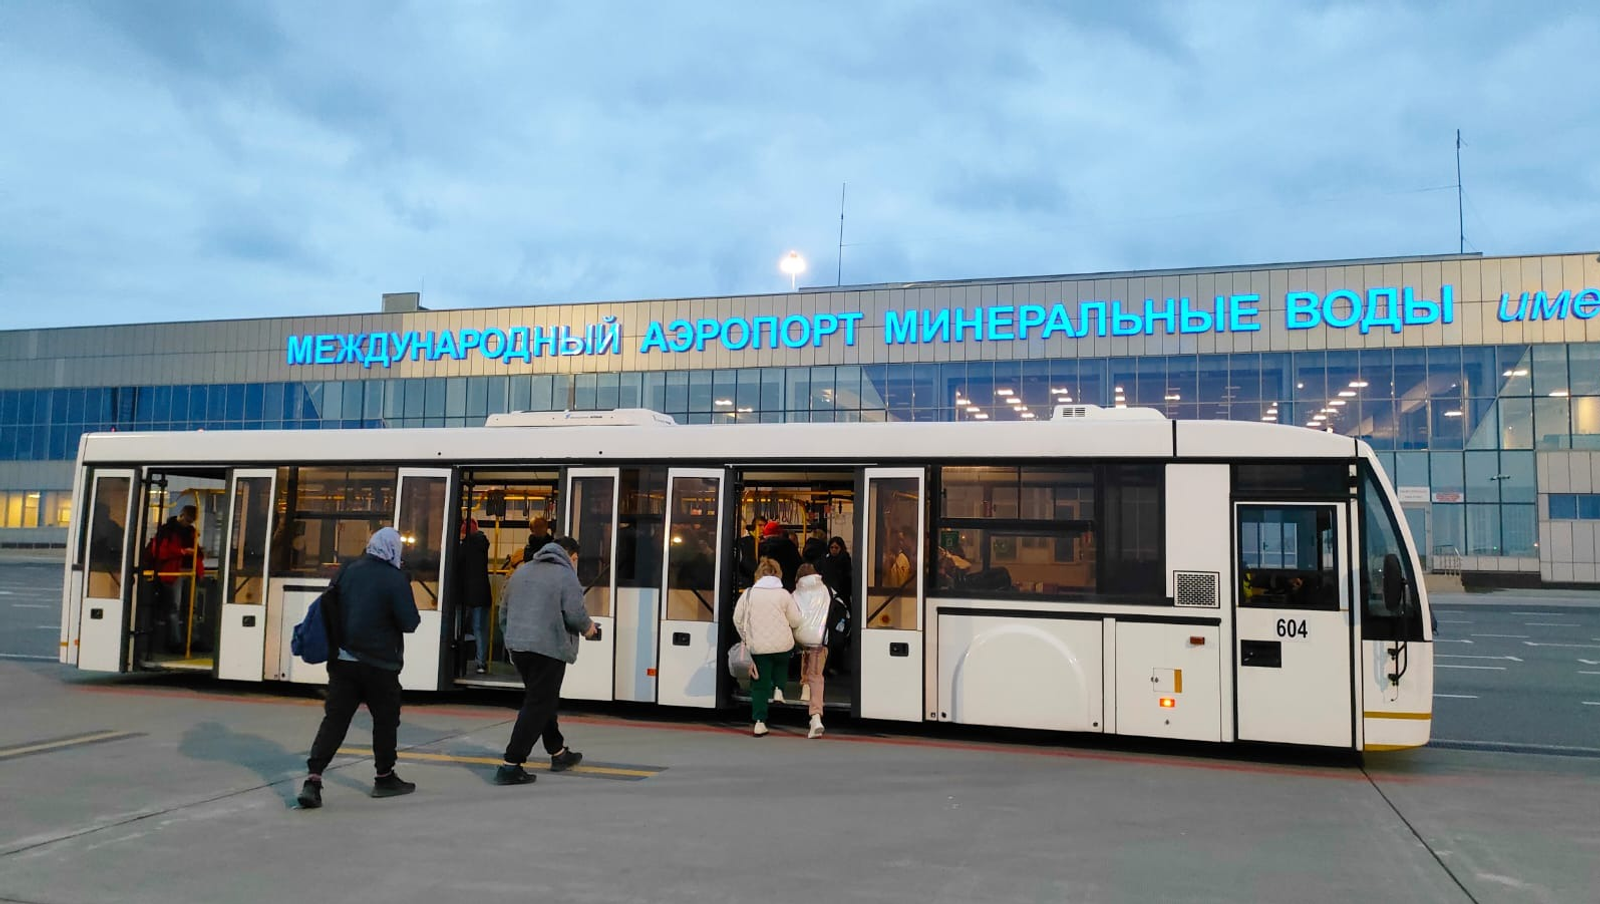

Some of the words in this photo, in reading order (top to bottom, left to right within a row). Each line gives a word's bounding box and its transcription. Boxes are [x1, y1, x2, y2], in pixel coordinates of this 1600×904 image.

[287, 315, 622, 369] МЕЖДУНАРОДНЫЙ
[640, 312, 863, 353] АЭРОПОРТ
[884, 294, 1261, 344] МИНЕРАЛЬНЫЕ
[1285, 285, 1453, 334] ВОДЫ
[1276, 618, 1308, 639] 604
